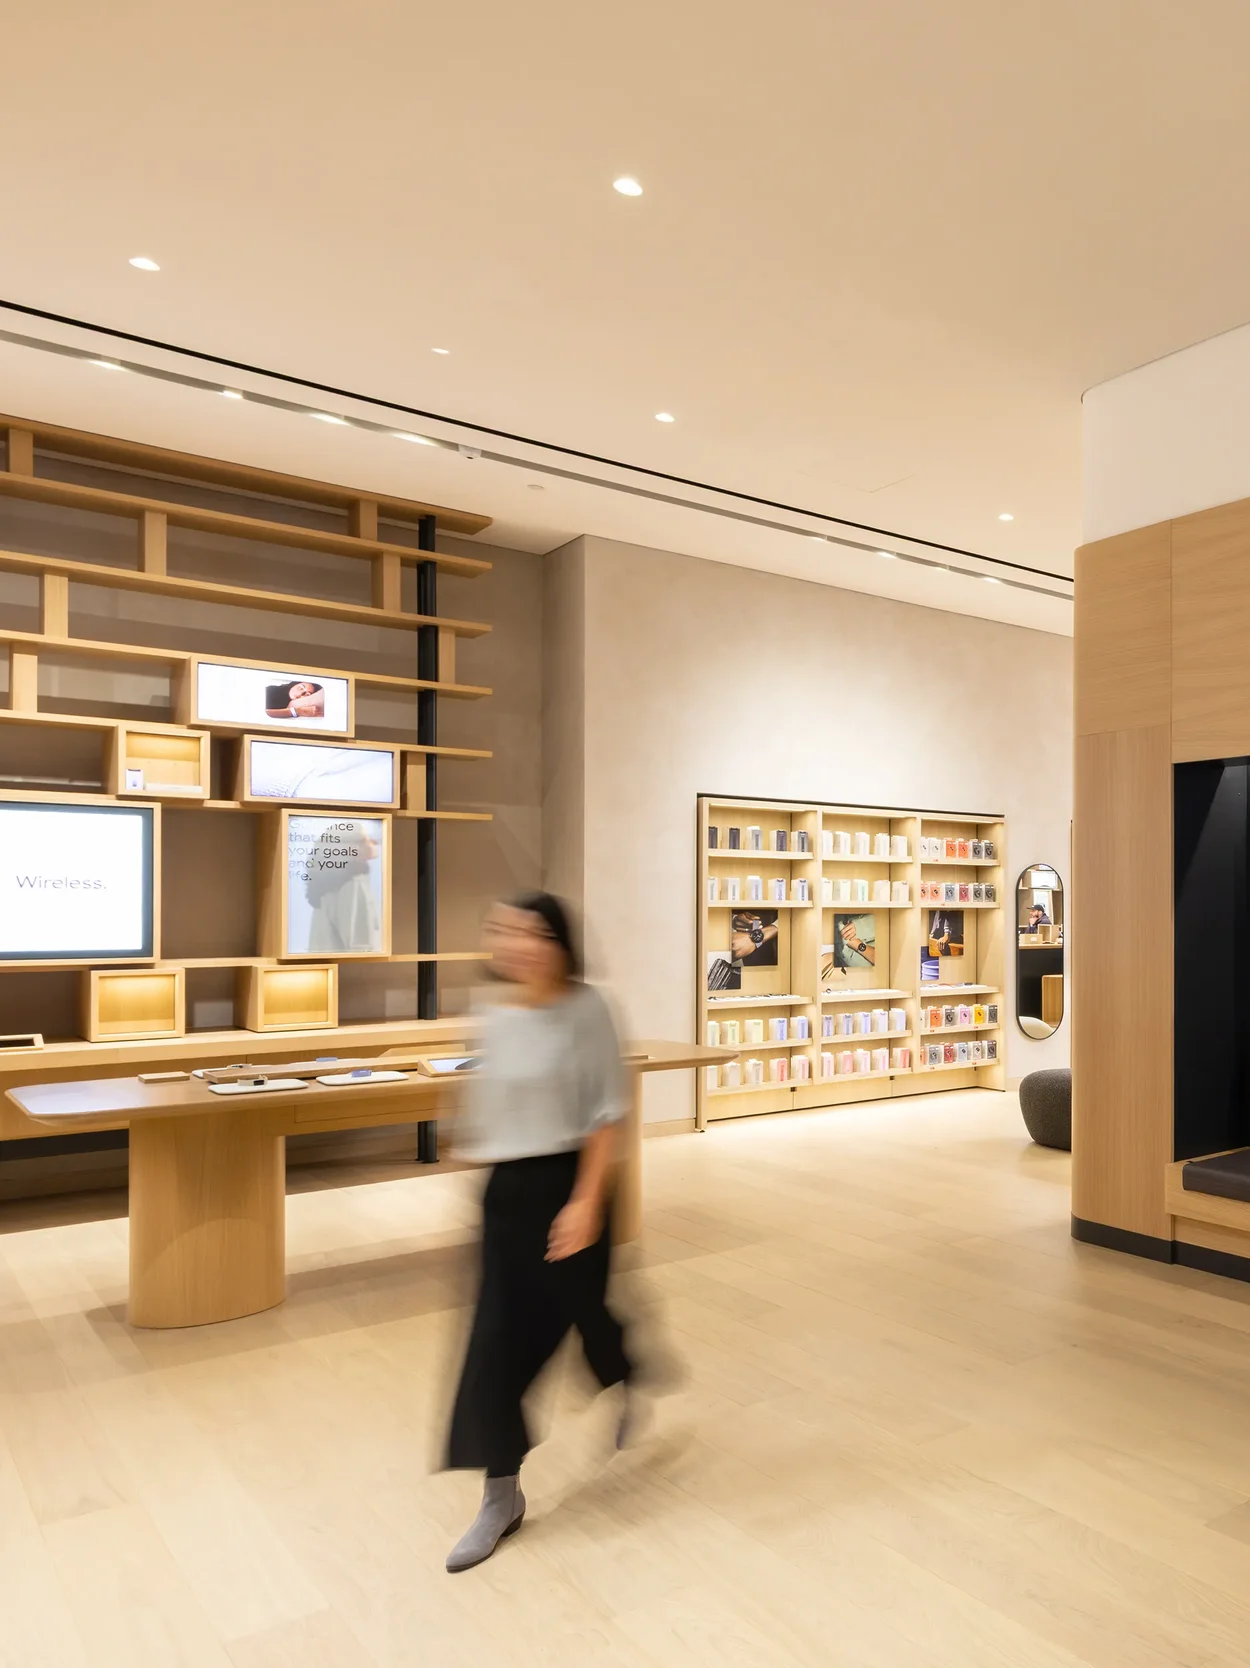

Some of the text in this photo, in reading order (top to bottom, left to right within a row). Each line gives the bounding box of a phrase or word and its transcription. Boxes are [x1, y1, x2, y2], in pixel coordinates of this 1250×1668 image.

[288, 832, 341, 844] that fits
[288, 846, 359, 859] your goals
[288, 858, 348, 871] and your
[15, 875, 107, 890] Wireless.
